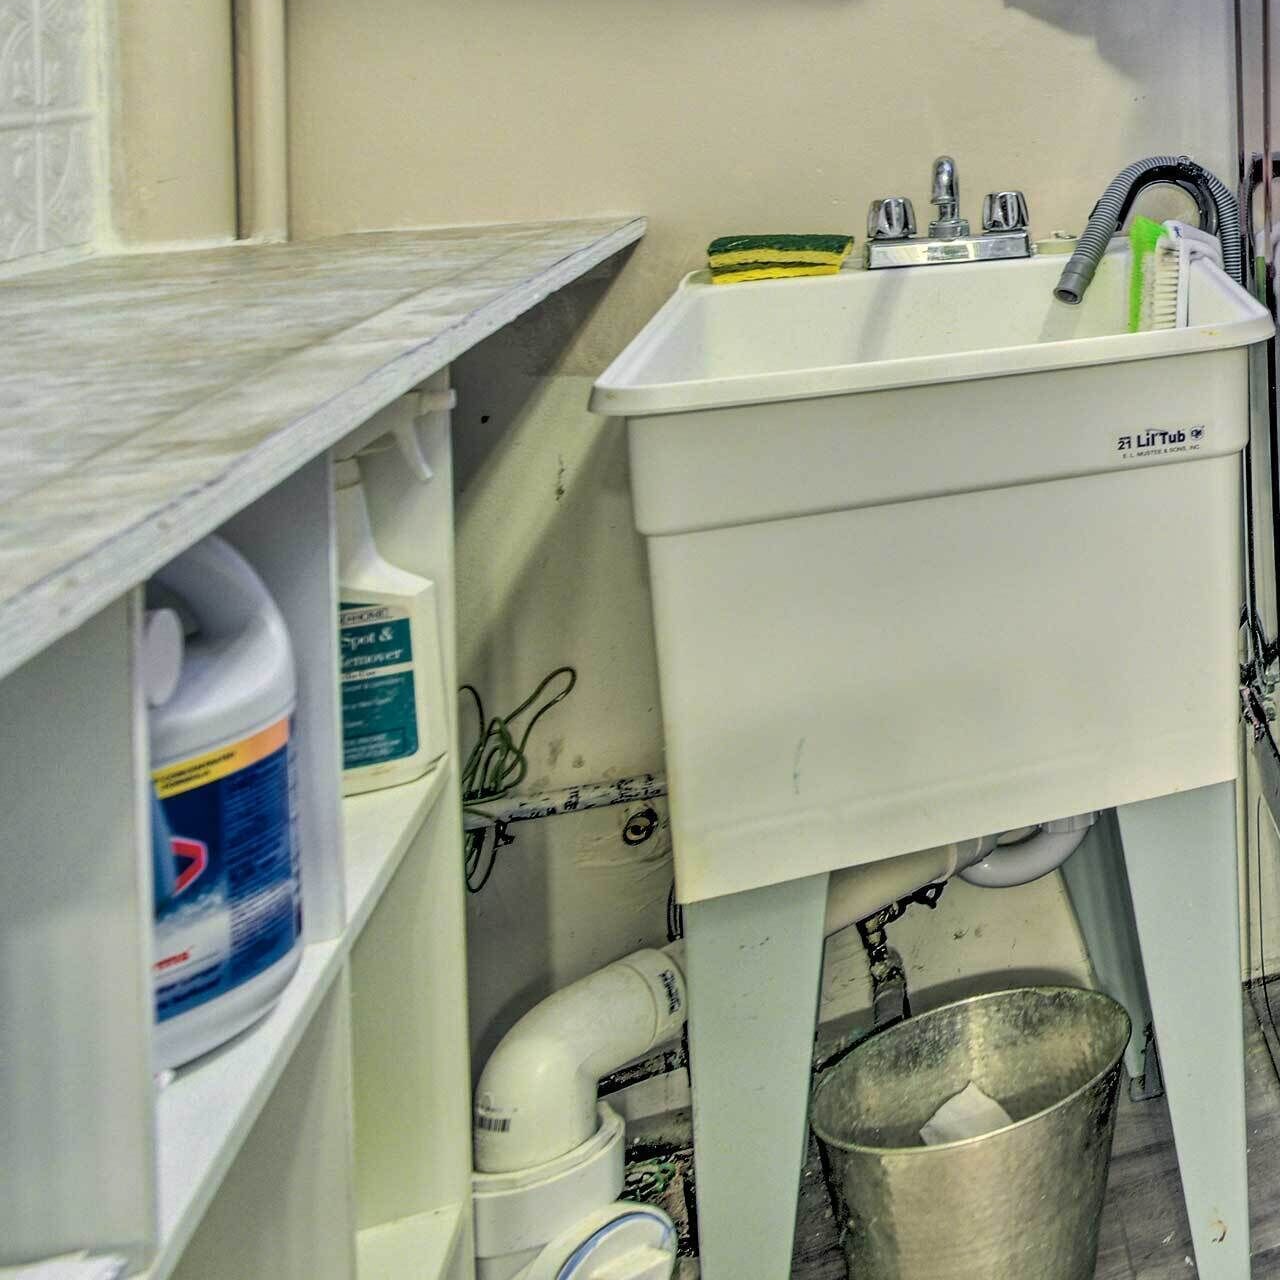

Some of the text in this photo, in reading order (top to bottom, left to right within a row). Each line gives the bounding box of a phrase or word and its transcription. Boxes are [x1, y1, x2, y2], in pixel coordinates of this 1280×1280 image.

[1118, 439, 1132, 450] 21
[378, 627, 394, 642] &
[341, 648, 403, 667] emover
